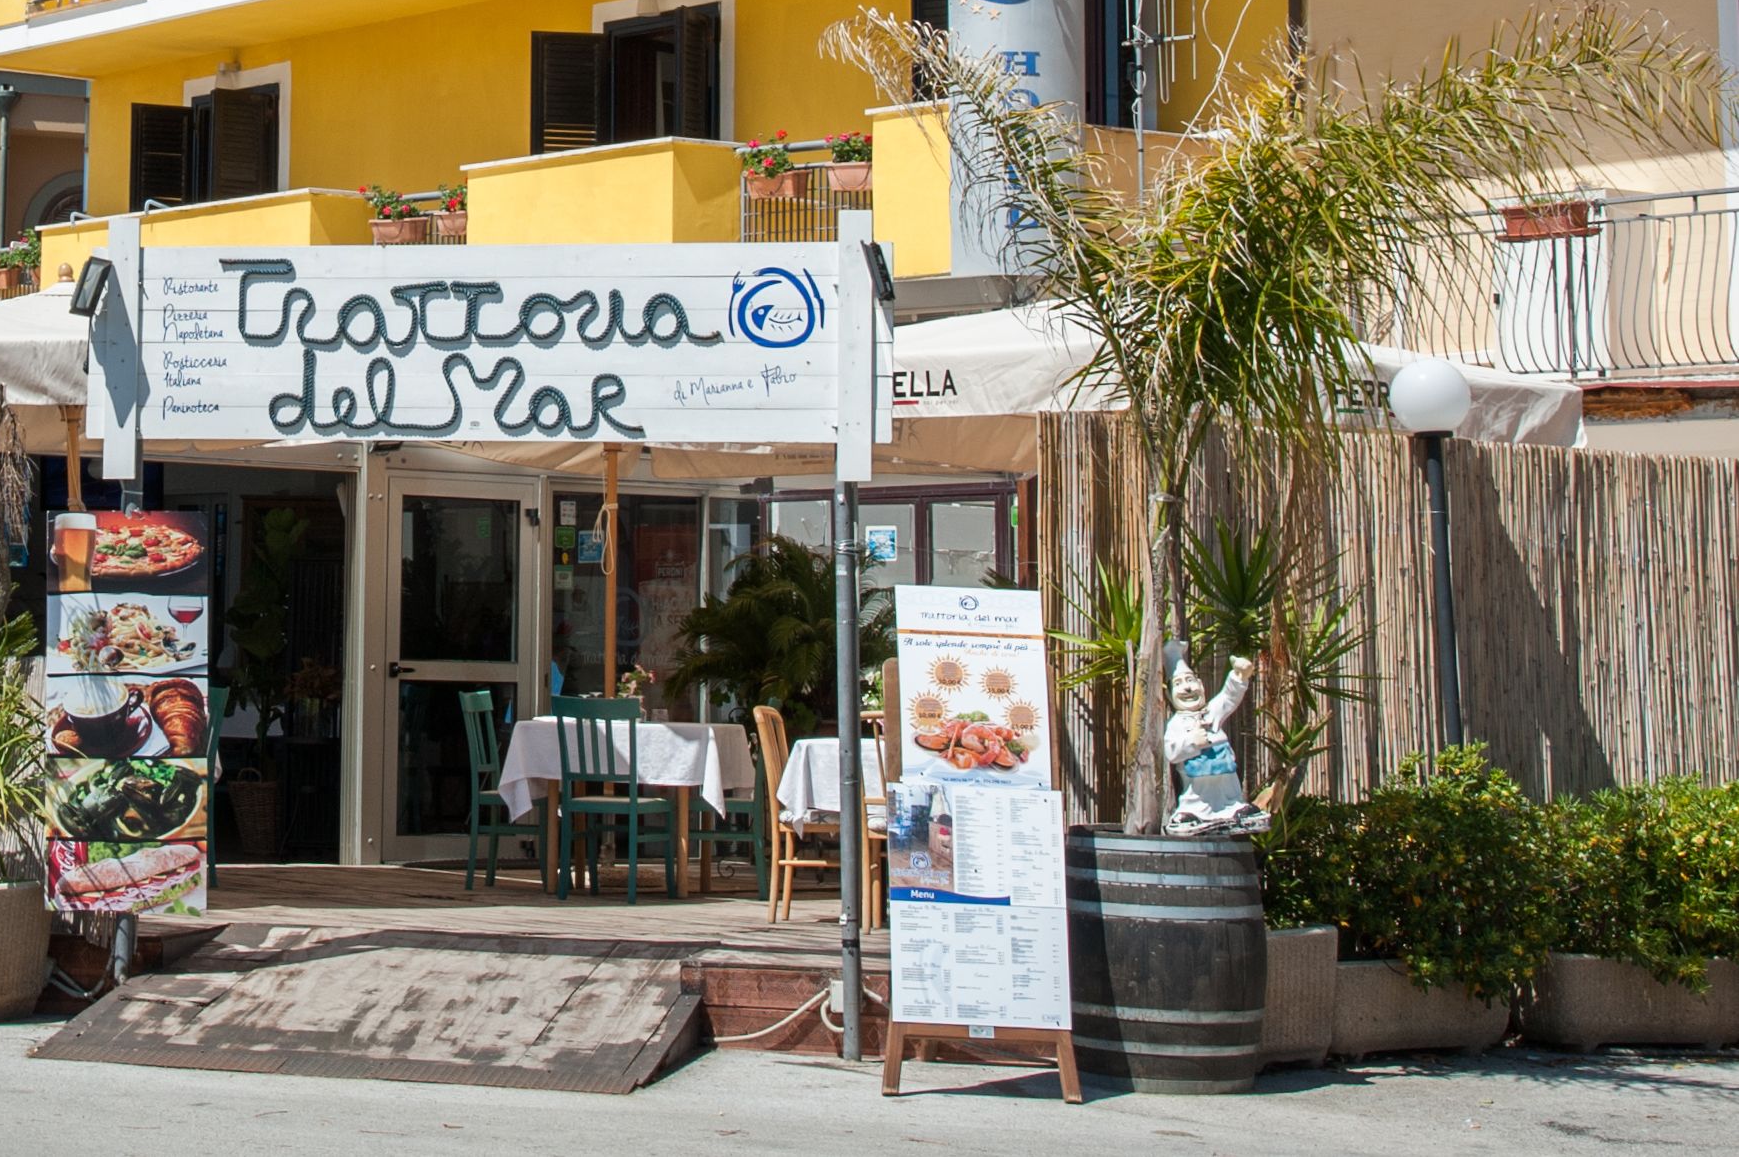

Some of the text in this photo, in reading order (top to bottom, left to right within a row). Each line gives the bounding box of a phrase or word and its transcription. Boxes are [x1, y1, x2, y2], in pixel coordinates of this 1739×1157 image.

[163, 277, 219, 295] Ristorante
[219, 258, 724, 347] Trattoria
[163, 303, 209, 328] Pizzeria
[163, 321, 225, 344] Napoletana
[163, 350, 227, 370] Rosticceria
[164, 370, 202, 388] Italiana
[269, 348, 396, 428] del
[673, 363, 798, 406] di Marianna e Fabio
[163, 395, 220, 420] Paninoteca
[910, 889, 935, 899] Menu
